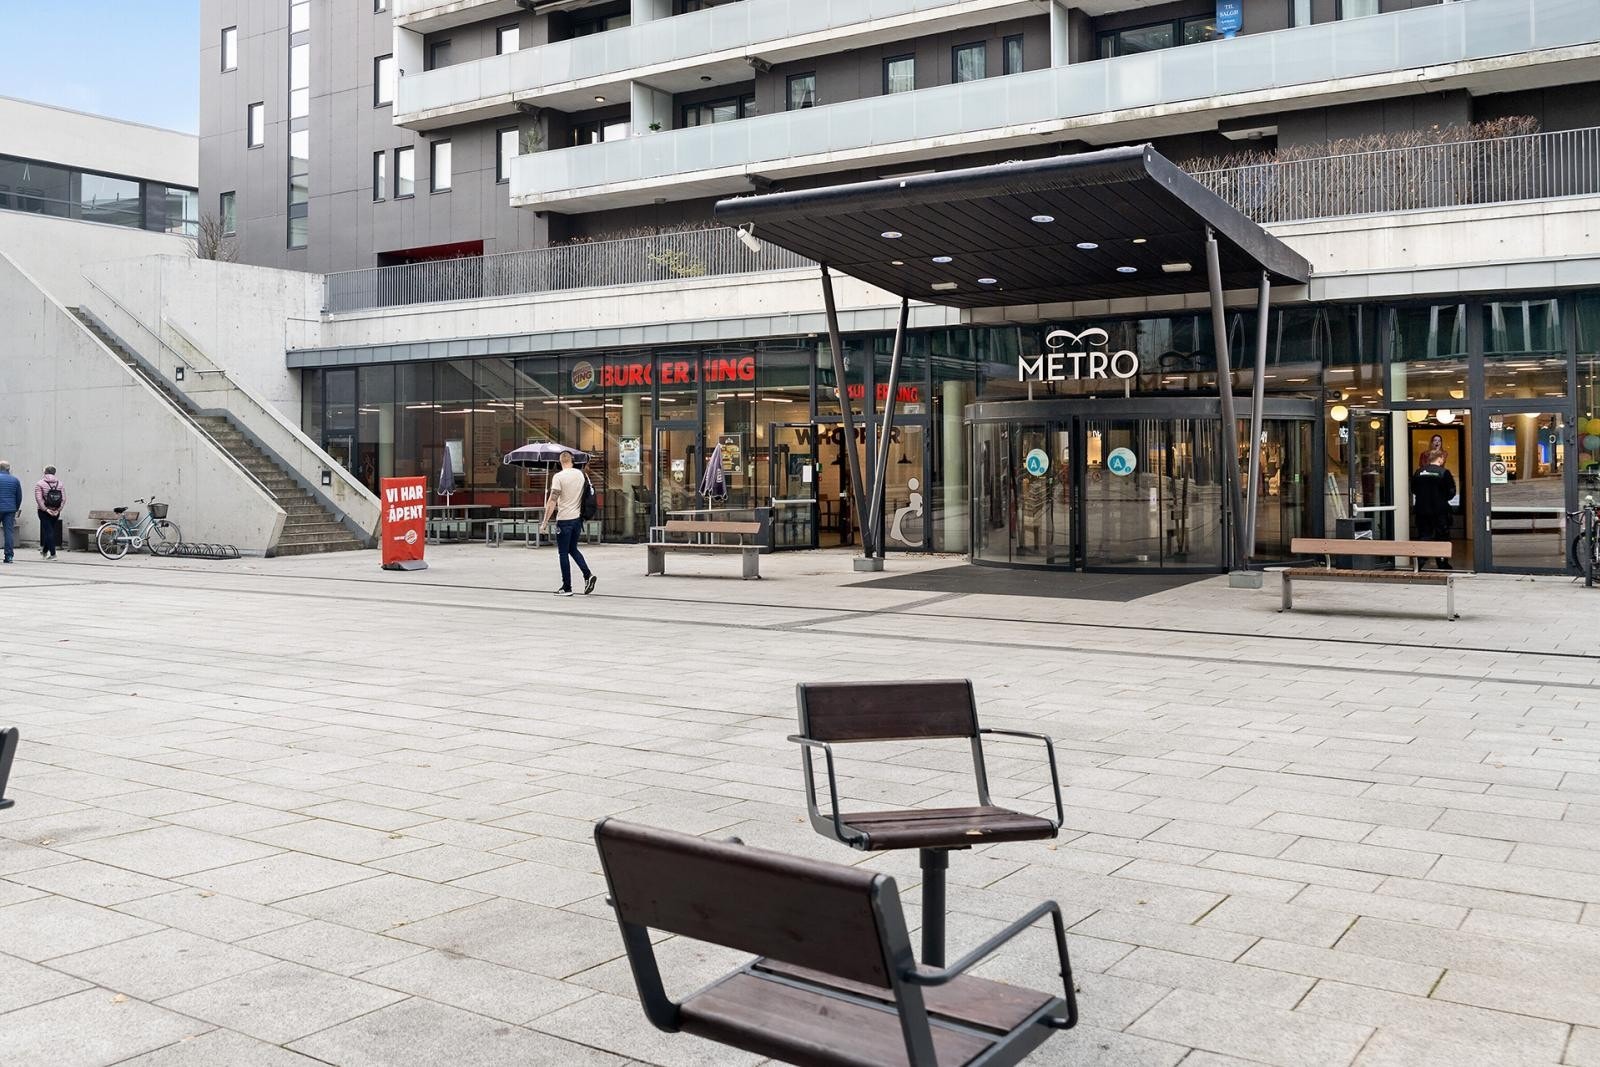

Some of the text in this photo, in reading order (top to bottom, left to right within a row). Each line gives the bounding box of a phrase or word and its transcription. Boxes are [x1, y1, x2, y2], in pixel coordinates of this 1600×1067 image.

[1019, 350, 1139, 382] METRO
[386, 485, 424, 503] VI HAR
[388, 504, 424, 523] ÅPENT
